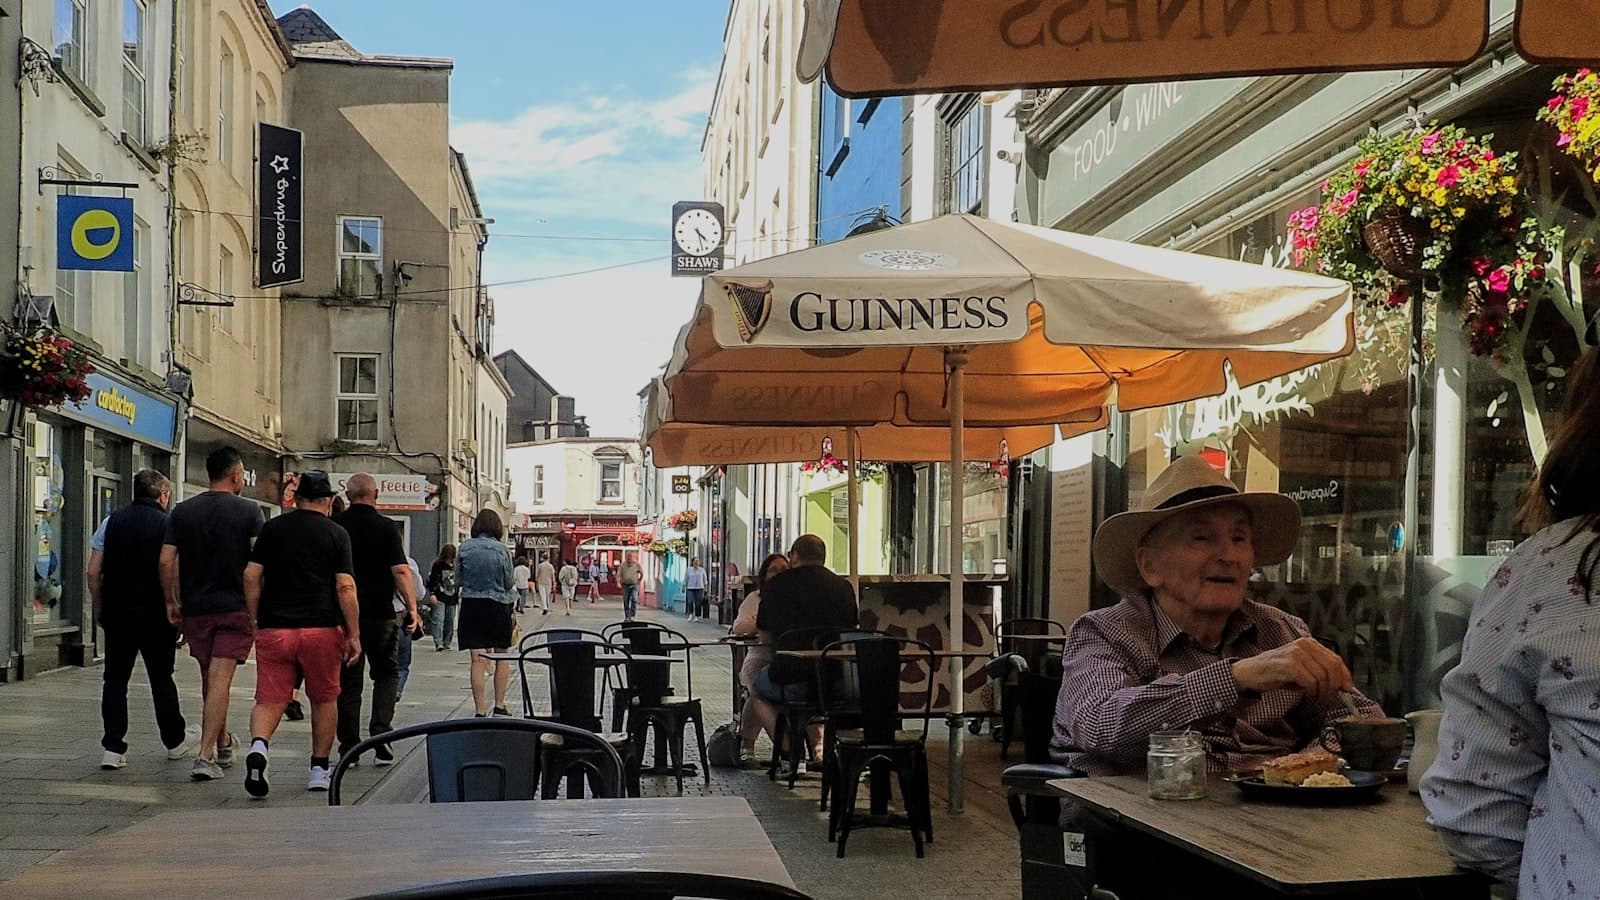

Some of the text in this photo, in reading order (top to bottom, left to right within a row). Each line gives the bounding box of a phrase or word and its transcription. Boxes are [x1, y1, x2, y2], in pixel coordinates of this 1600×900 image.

[1074, 121, 1118, 181] FOOD
[272, 177, 289, 274] Superdrug
[789, 292, 1009, 332] GUINNESS
[380, 479, 421, 493] Feetie
